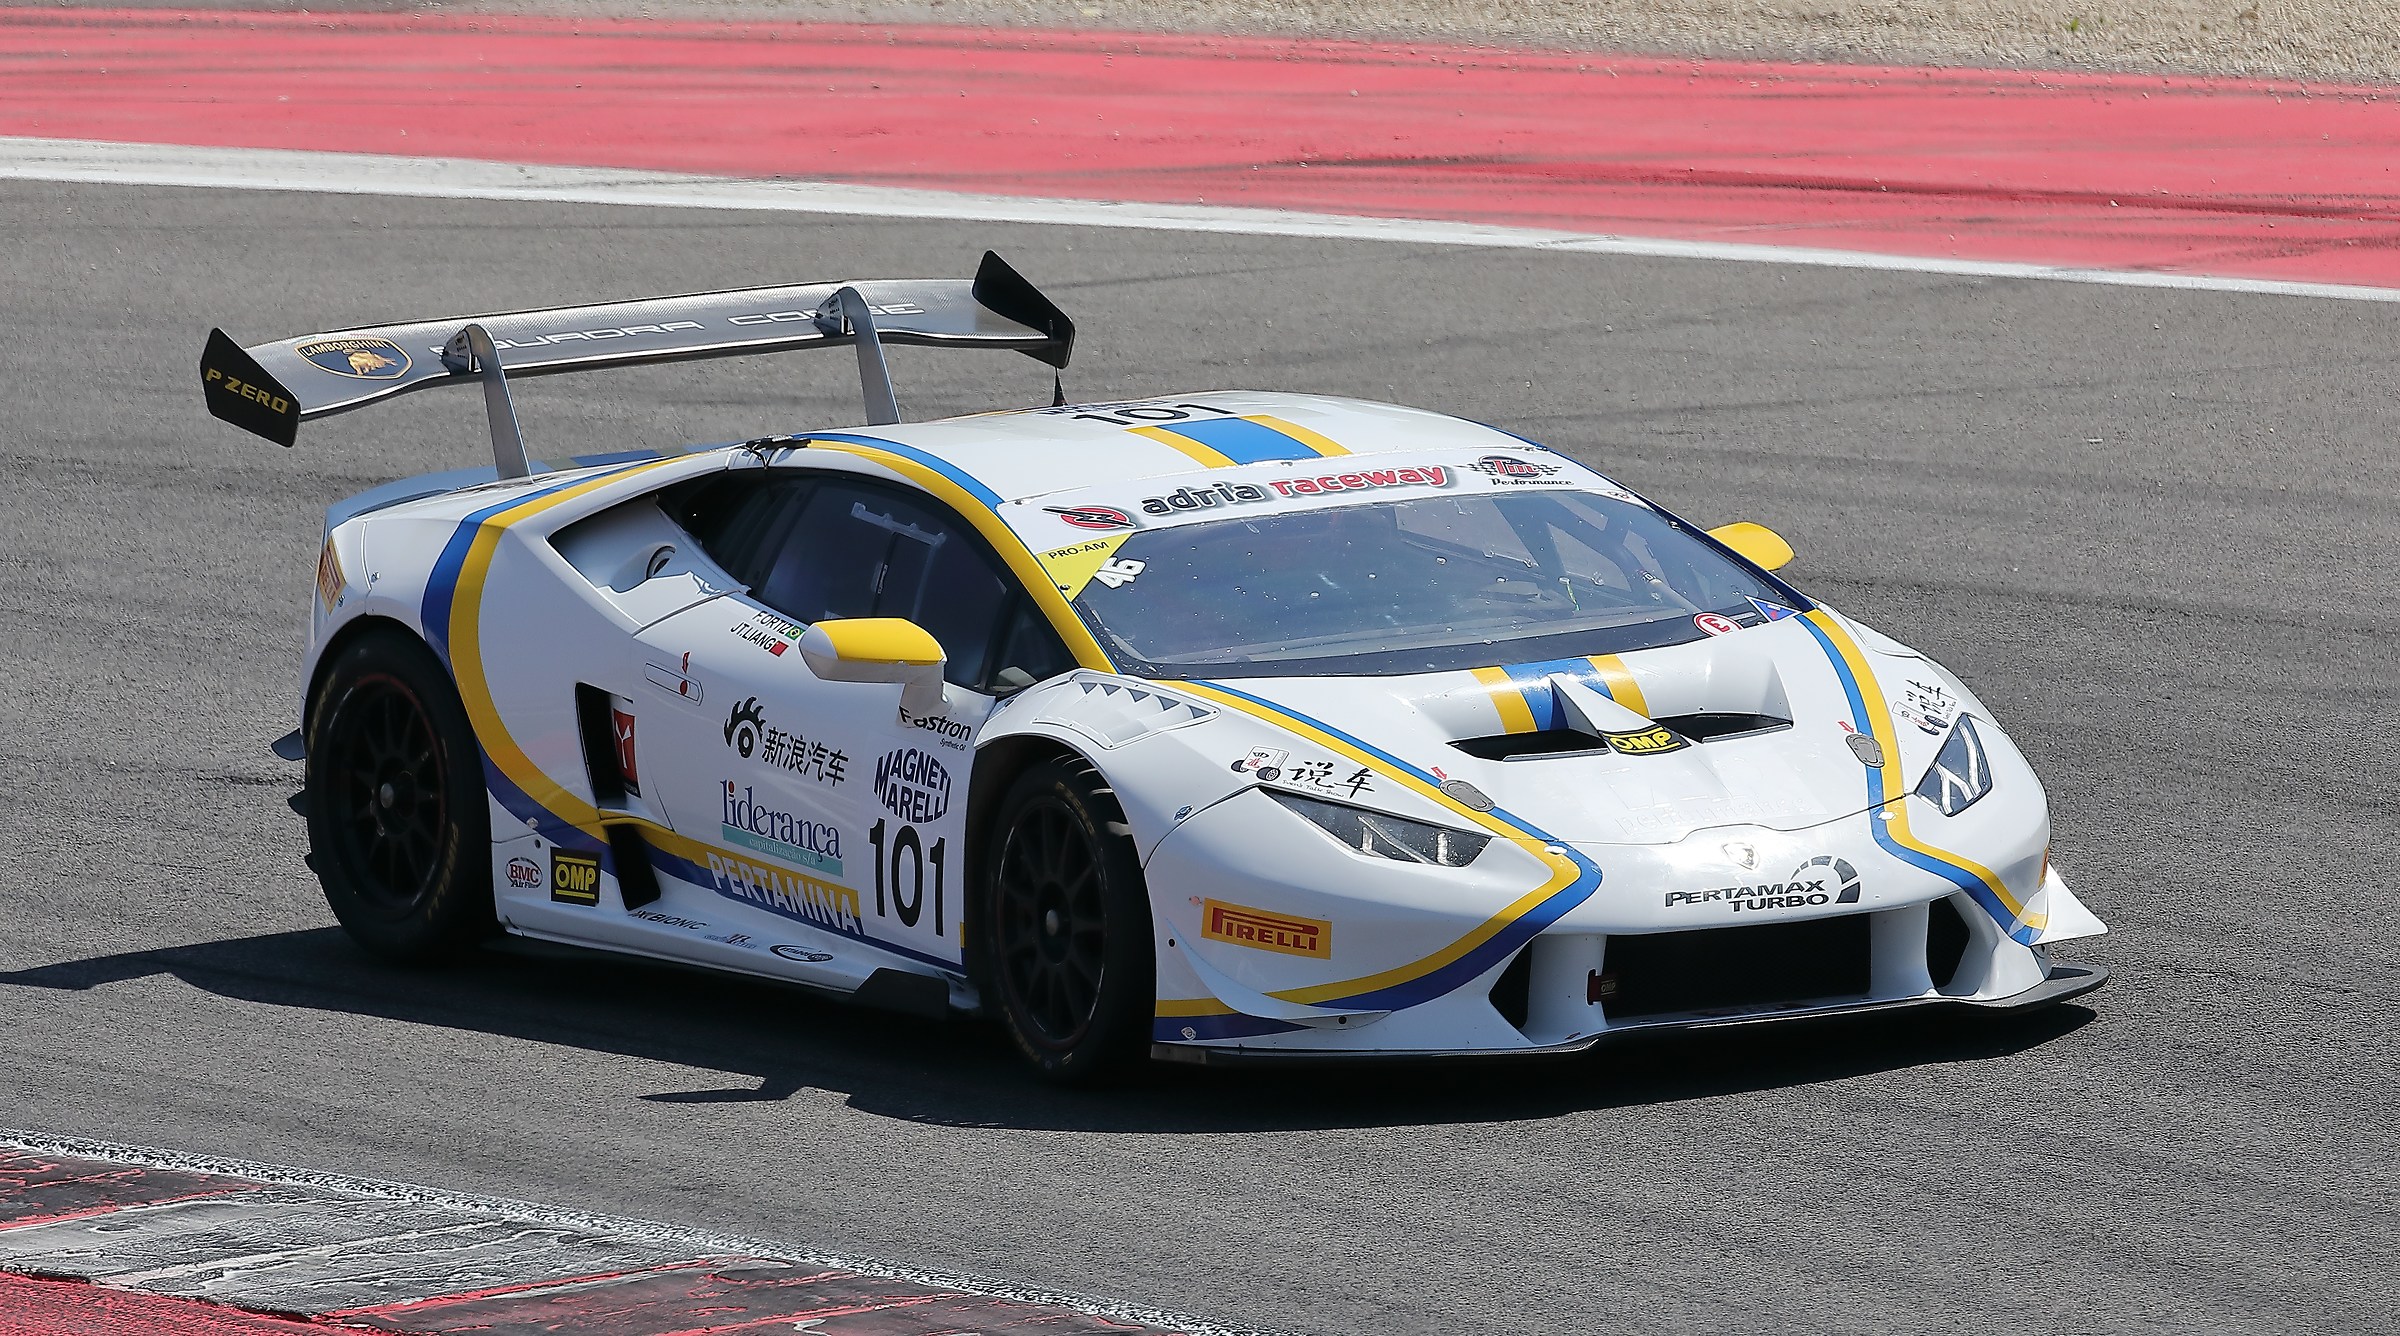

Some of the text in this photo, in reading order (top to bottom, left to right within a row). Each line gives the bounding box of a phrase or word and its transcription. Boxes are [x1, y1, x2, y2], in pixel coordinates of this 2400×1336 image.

[300, 339, 389, 357] LAMBORGHINI
[205, 367, 288, 415] P ZERO
[1070, 403, 1239, 426] 101
[1141, 465, 1447, 516] adria raceway
[1488, 477, 1575, 487] Performance
[1048, 541, 1110, 560] PRO-AM
[1094, 555, 1147, 590] 46
[730, 621, 777, 650] JT.LIANG
[899, 705, 972, 742] Fastron
[1609, 731, 1672, 750] OMP
[762, 727, 849, 788] 新浪汽车
[874, 748, 952, 803] MAGNETI
[1287, 761, 1376, 799] 说车
[874, 771, 952, 824] MARELLI
[720, 779, 843, 863] liderança
[749, 837, 817, 866] capitalização s/a
[509, 864, 539, 883] BMC
[555, 863, 597, 892] OMP
[869, 817, 945, 937] 101
[706, 852, 865, 935] PERTAMINA
[1665, 879, 1826, 907] PERTAMAX
[1729, 893, 1830, 913] TURBO
[1211, 907, 1320, 951] PIRELLI
